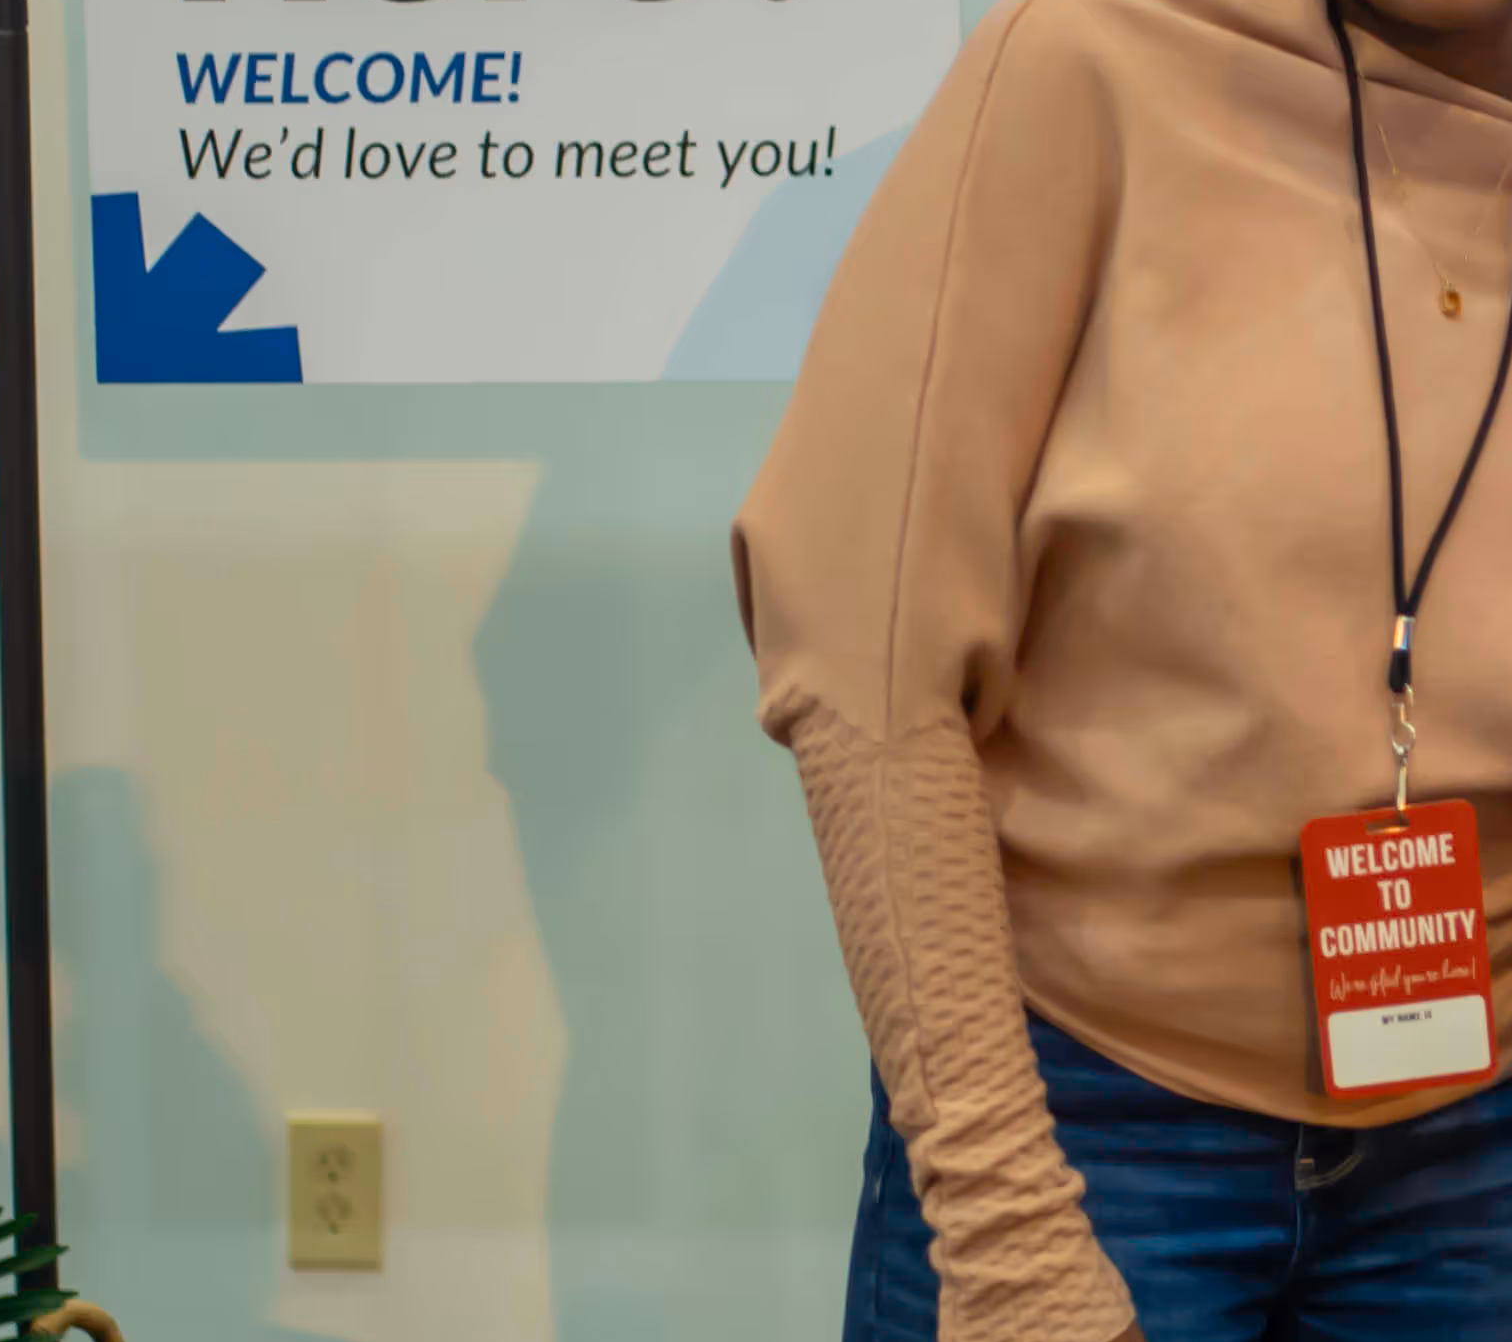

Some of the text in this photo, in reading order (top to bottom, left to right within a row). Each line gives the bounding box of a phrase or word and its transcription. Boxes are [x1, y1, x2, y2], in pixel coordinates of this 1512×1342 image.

[176, 51, 523, 105] WELCOME!
[178, 126, 836, 190] We'd love to meet you!
[1326, 833, 1455, 878] WELCOME
[1378, 878, 1411, 911] TO
[1320, 909, 1476, 958] COMMUNITY
